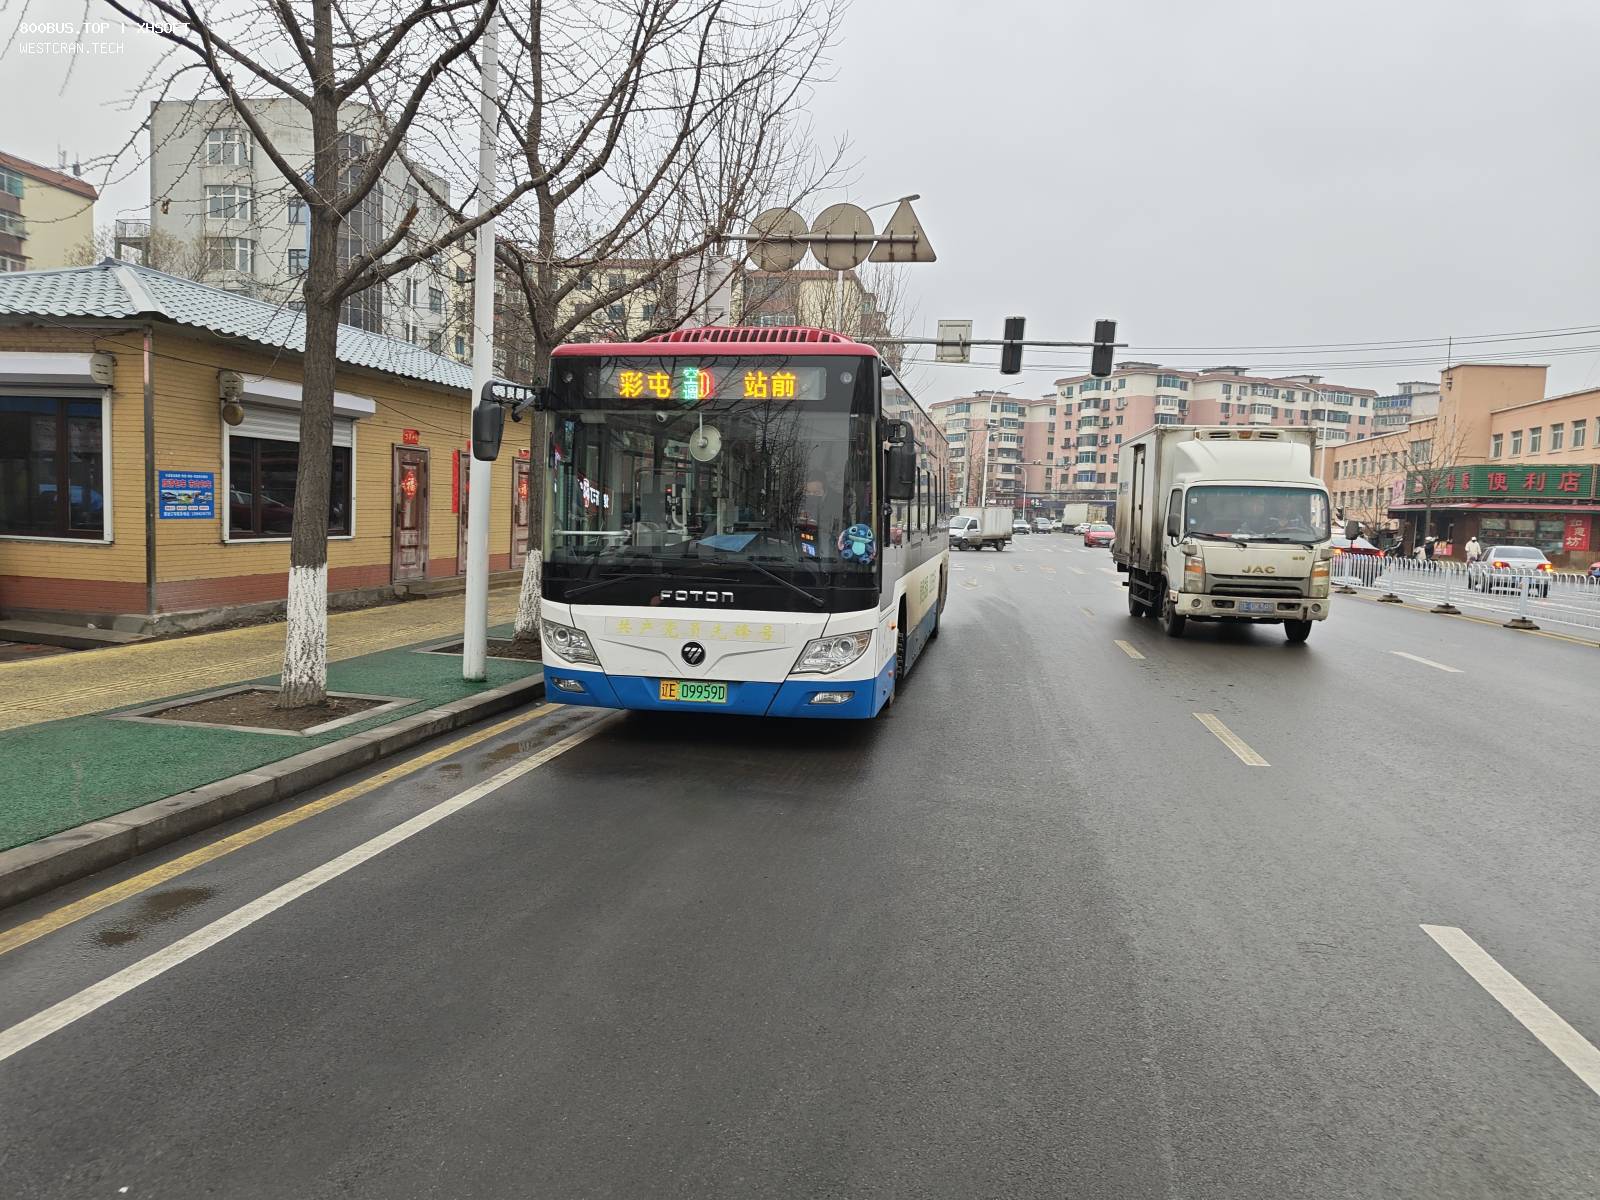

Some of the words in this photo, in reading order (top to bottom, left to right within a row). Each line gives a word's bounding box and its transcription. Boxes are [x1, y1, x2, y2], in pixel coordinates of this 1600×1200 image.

[619, 371, 671, 398] 彩屯
[744, 371, 796, 398] 站前
[1487, 471, 1584, 493] 便利店
[1241, 566, 1276, 574] JAC
[660, 589, 735, 604] FOTON
